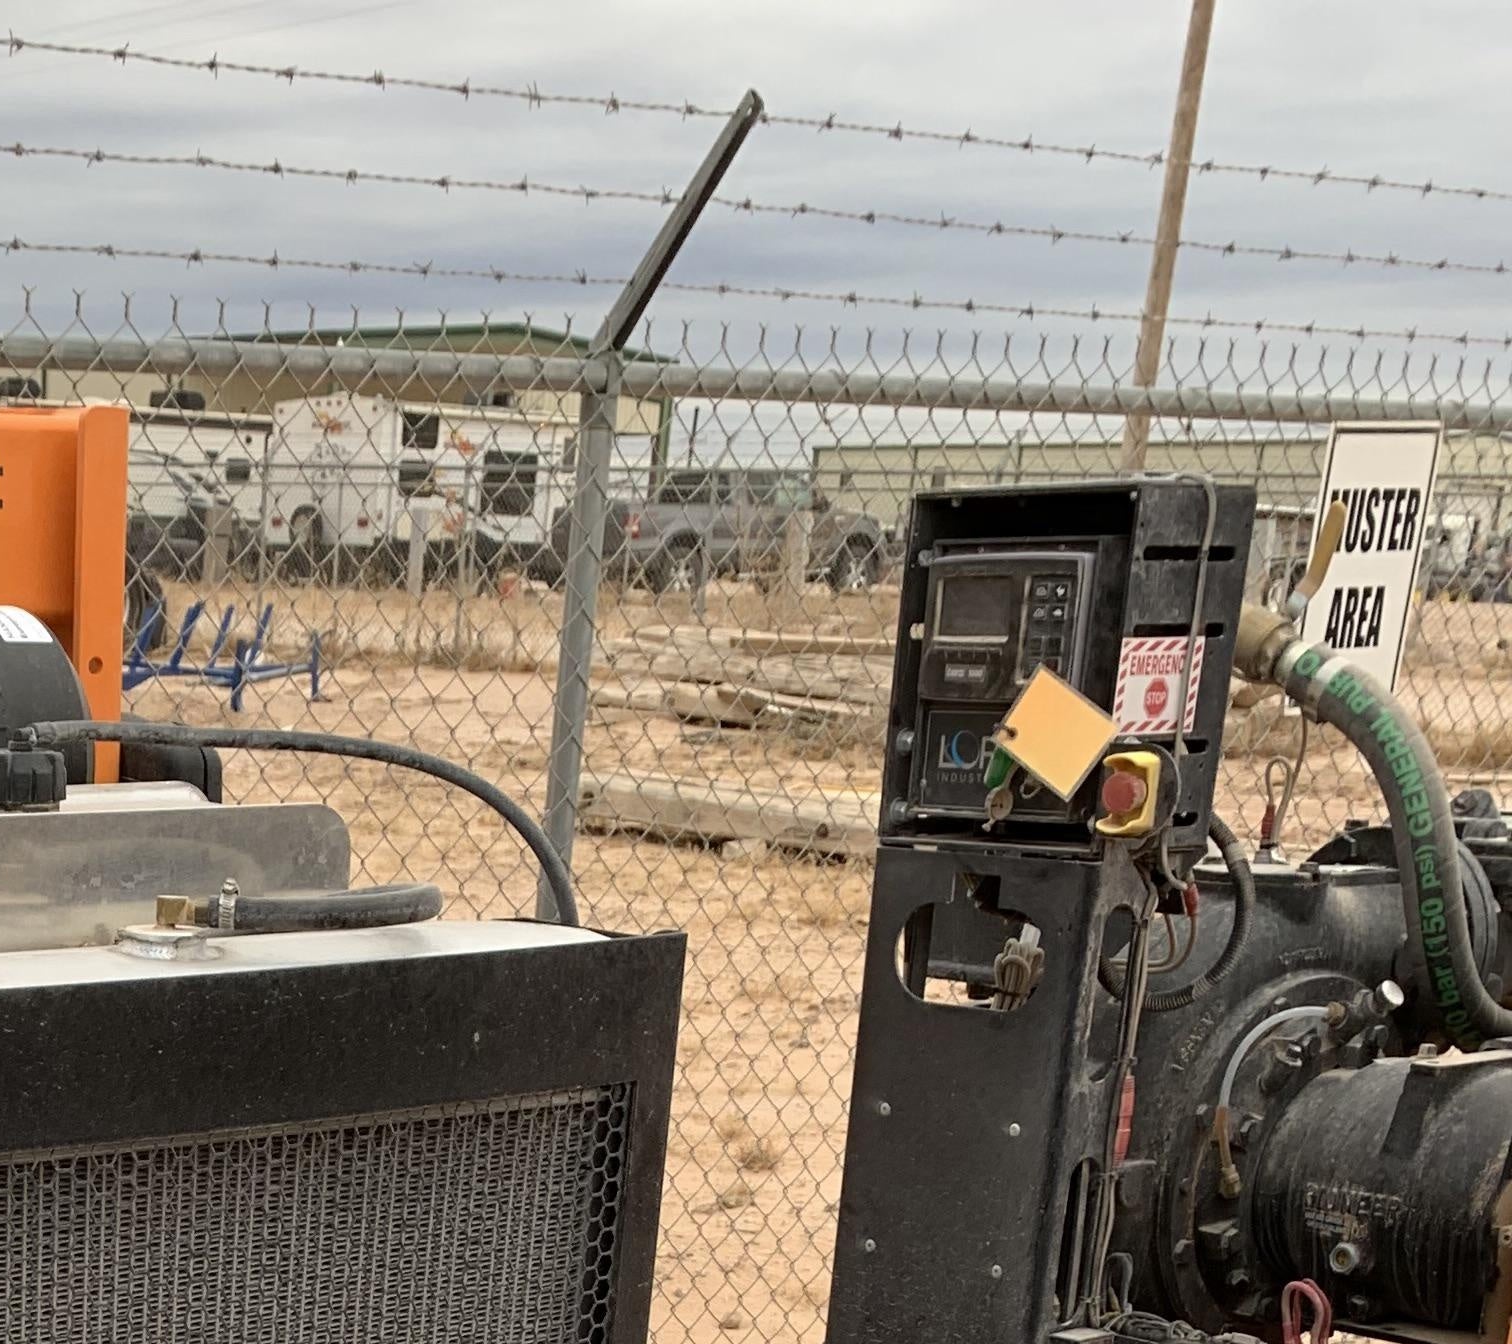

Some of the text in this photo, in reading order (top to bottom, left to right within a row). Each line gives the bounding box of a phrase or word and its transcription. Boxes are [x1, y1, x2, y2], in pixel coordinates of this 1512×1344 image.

[1324, 585, 1386, 649] AREA
[1129, 654, 1186, 676] EMERGENC
[1146, 691, 1166, 705] STOP
[936, 771, 983, 784] INDUST
[1369, 708, 1435, 840] GENERAL
[1414, 843, 1445, 892] psi)
[1420, 897, 1450, 959] (150
[1434, 963, 1459, 1007] bar
